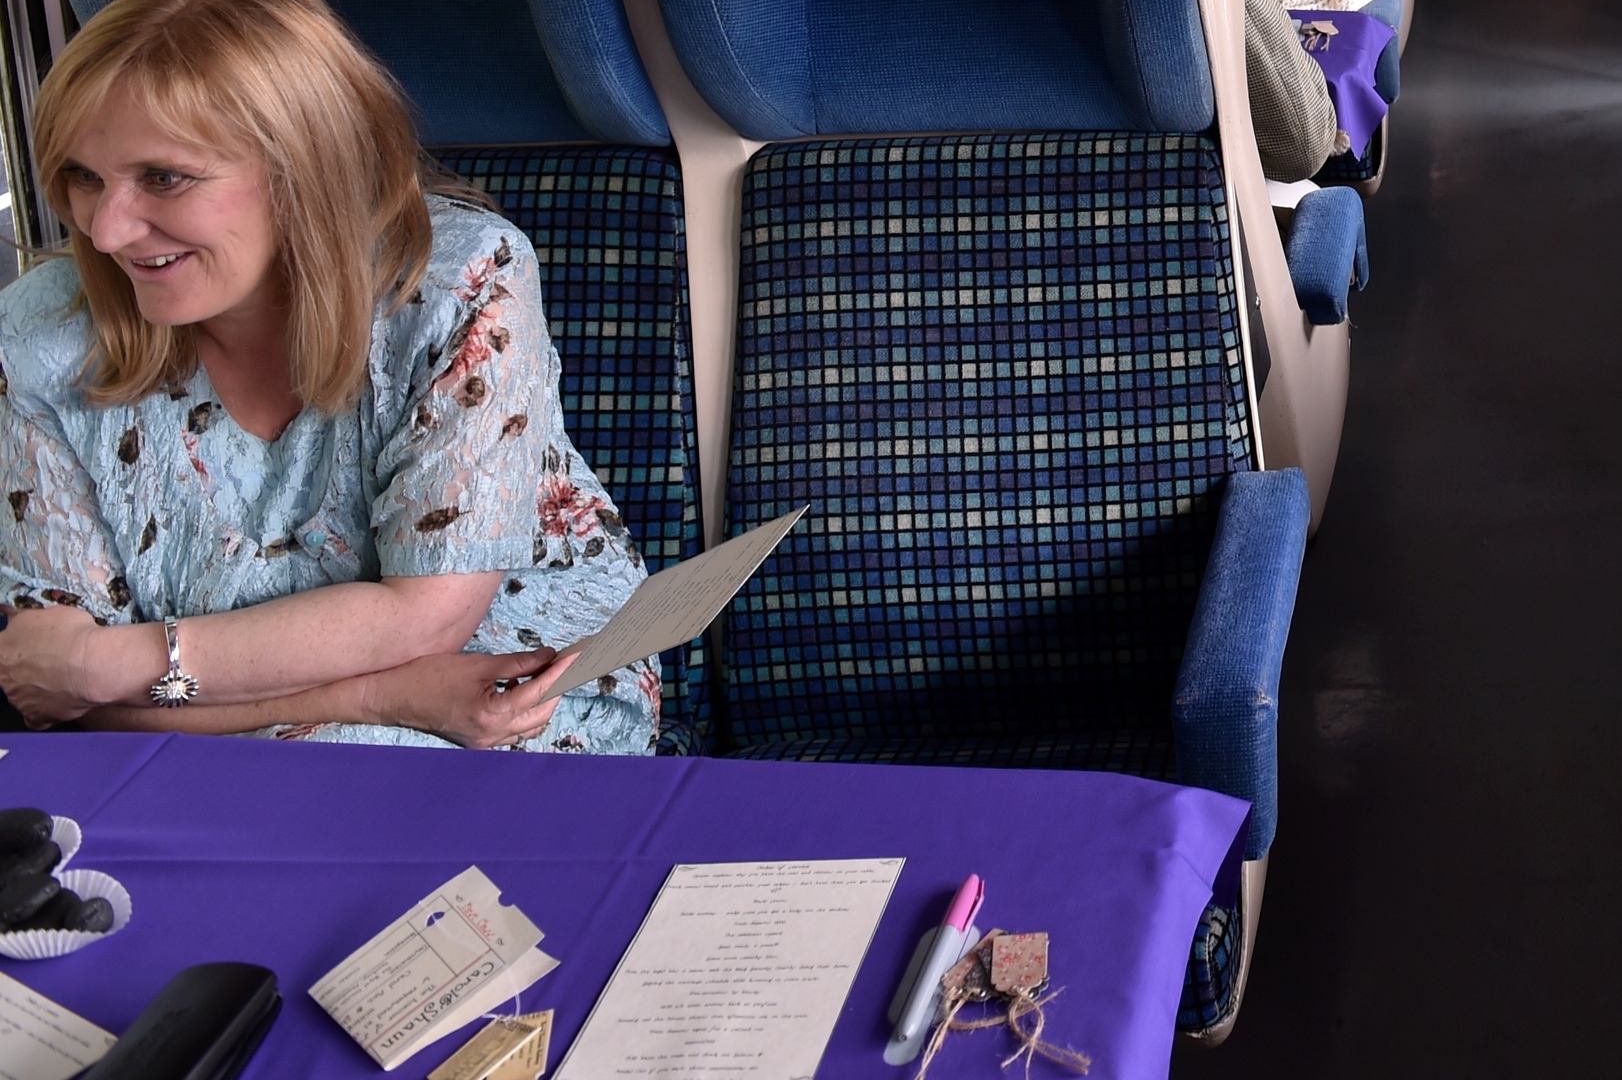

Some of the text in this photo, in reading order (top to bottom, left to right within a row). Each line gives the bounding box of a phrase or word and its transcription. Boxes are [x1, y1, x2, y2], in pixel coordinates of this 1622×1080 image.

[387, 968, 412, 989] Carol
[374, 985, 418, 1019] requested
[385, 997, 418, 1023] honour
